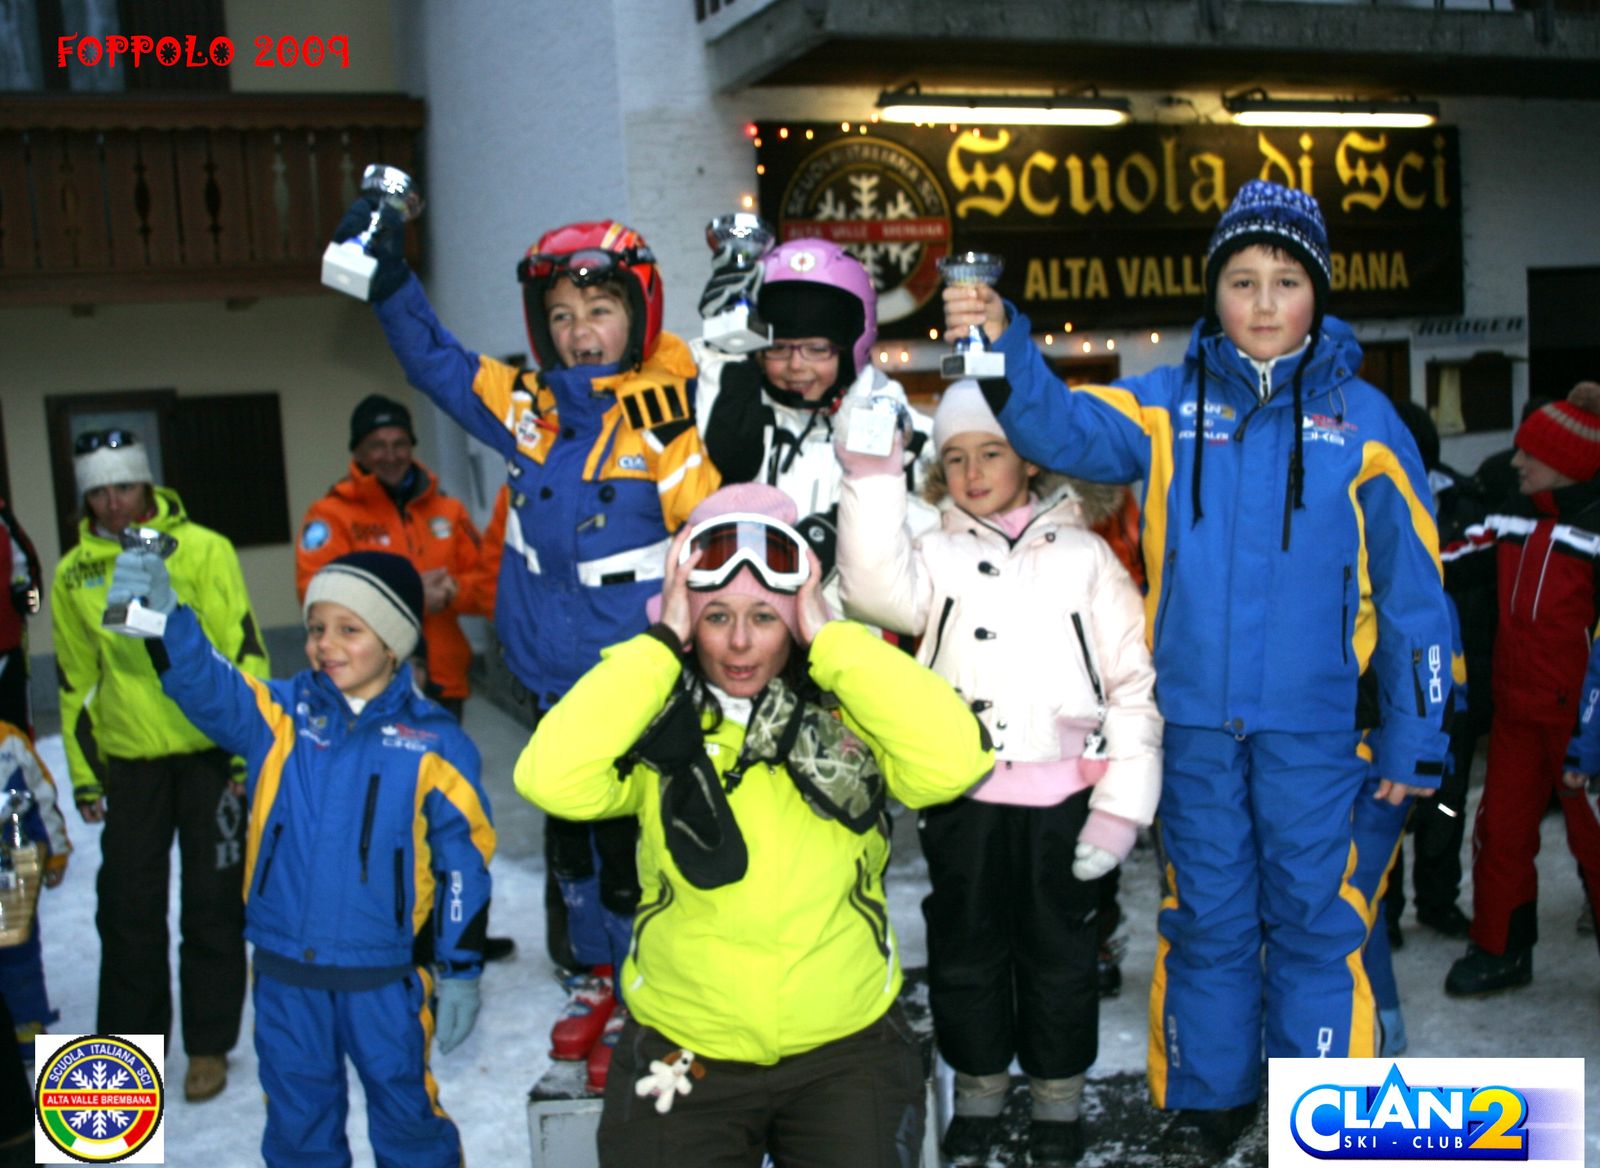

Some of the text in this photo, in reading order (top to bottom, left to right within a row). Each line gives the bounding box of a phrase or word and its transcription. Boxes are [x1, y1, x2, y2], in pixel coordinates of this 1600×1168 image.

[947, 129, 1448, 219] Scuola di Sci
[1024, 251, 1410, 300] ALTA VALL BANA
